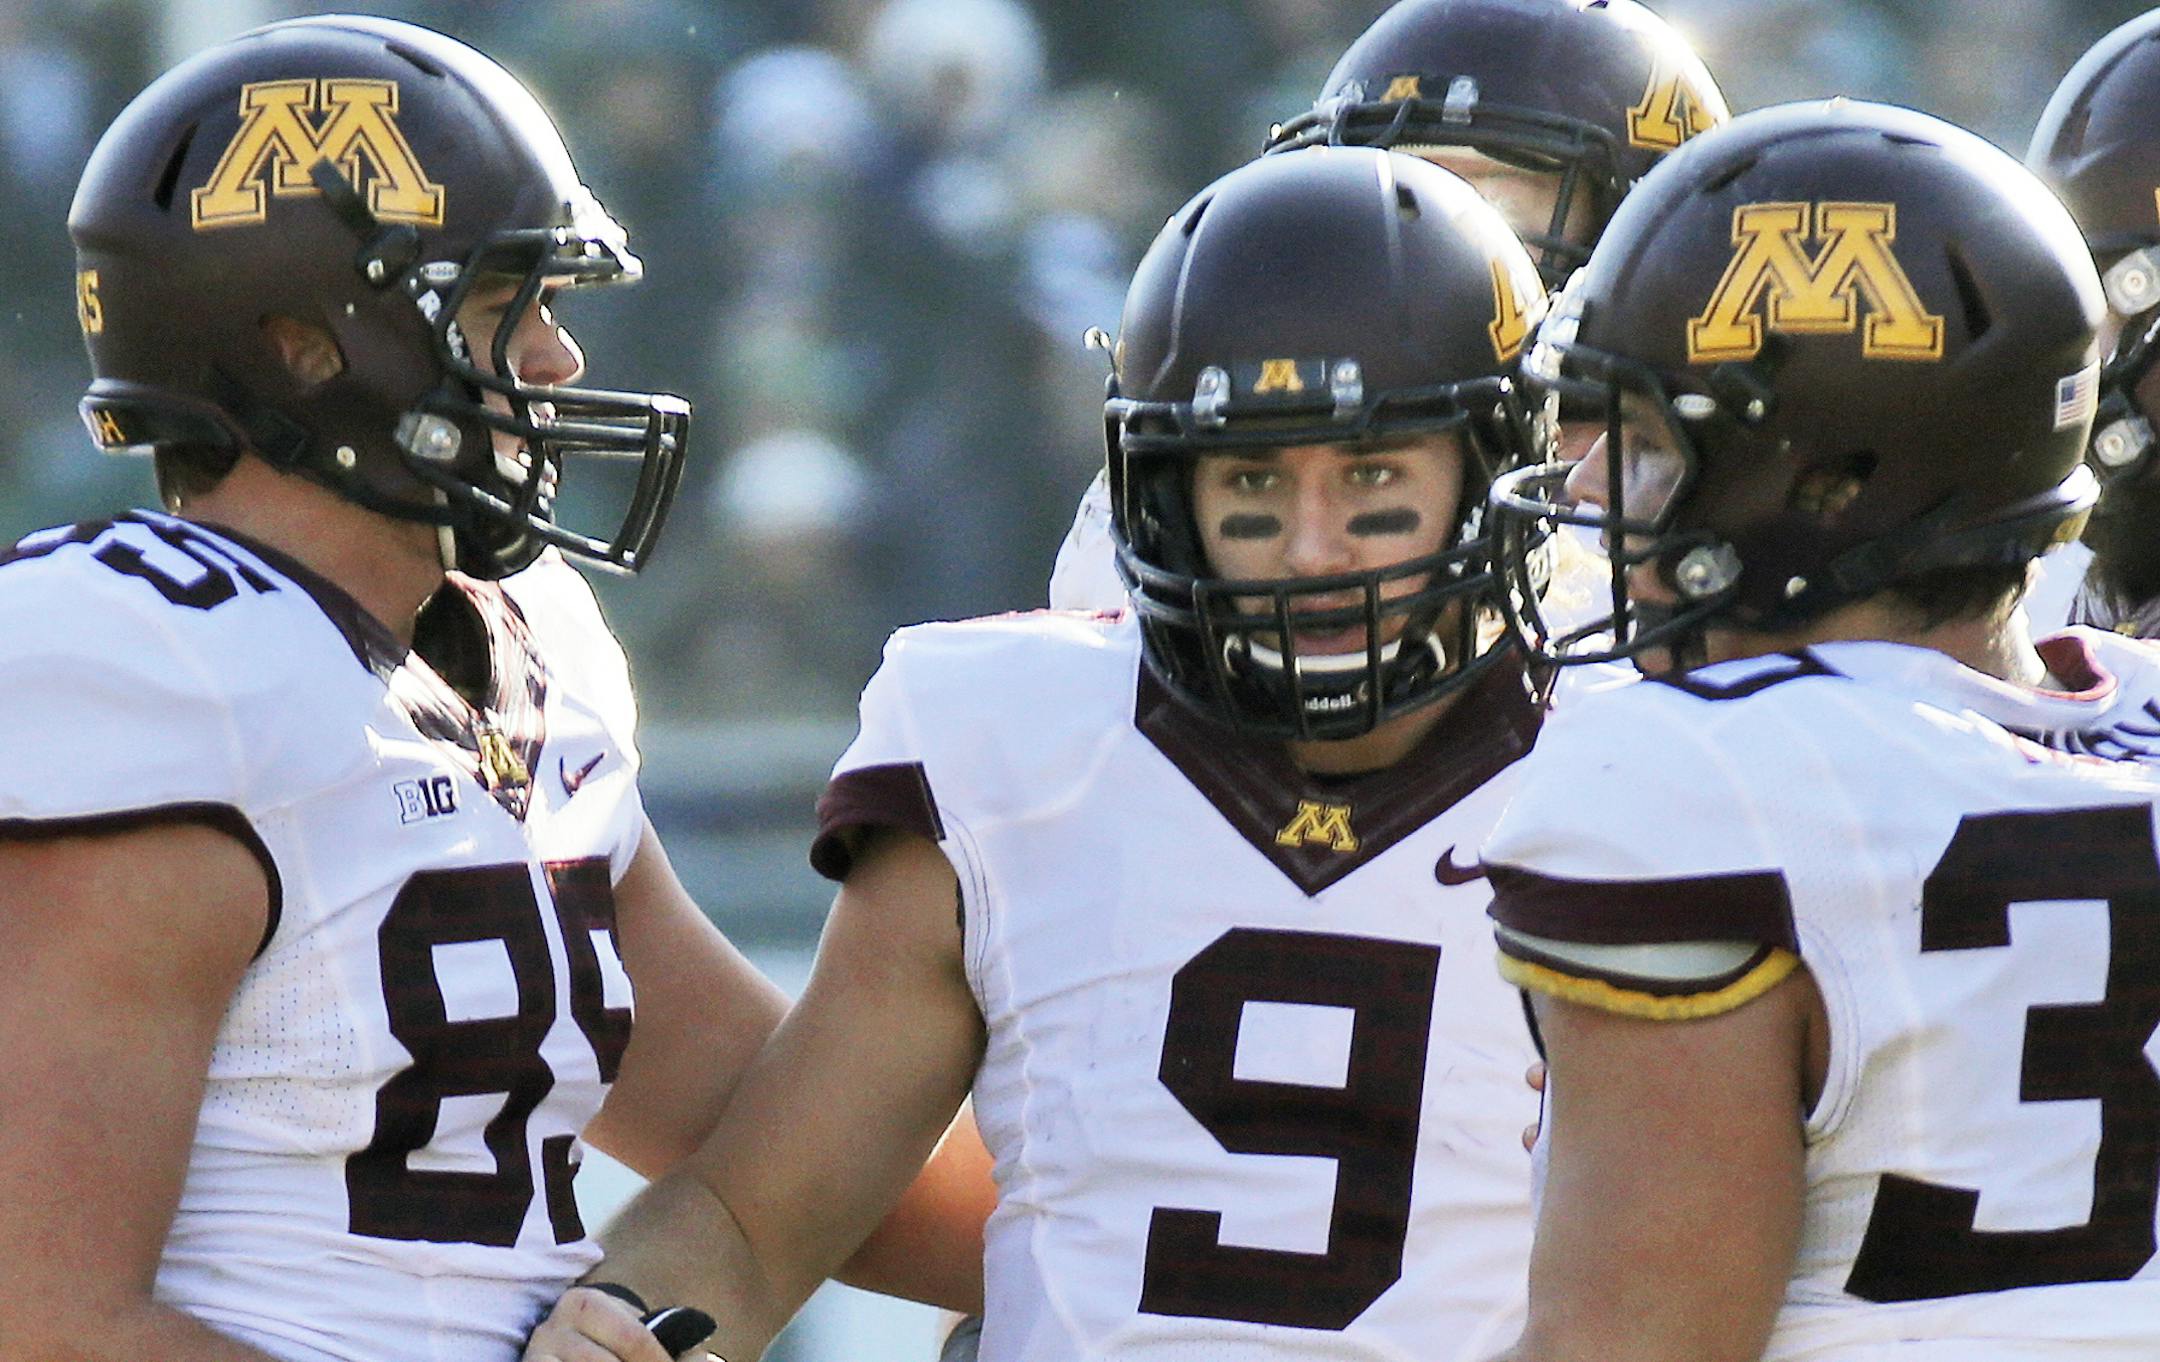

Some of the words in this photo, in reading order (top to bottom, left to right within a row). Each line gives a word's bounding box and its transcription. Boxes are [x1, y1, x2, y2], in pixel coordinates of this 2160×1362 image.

[191, 78, 445, 230] M
[1688, 202, 1944, 364] M
[1253, 359, 1304, 394] M
[1274, 800, 1358, 852] M
[1137, 927, 1442, 1331] 9
[1843, 801, 2160, 1304] 3
